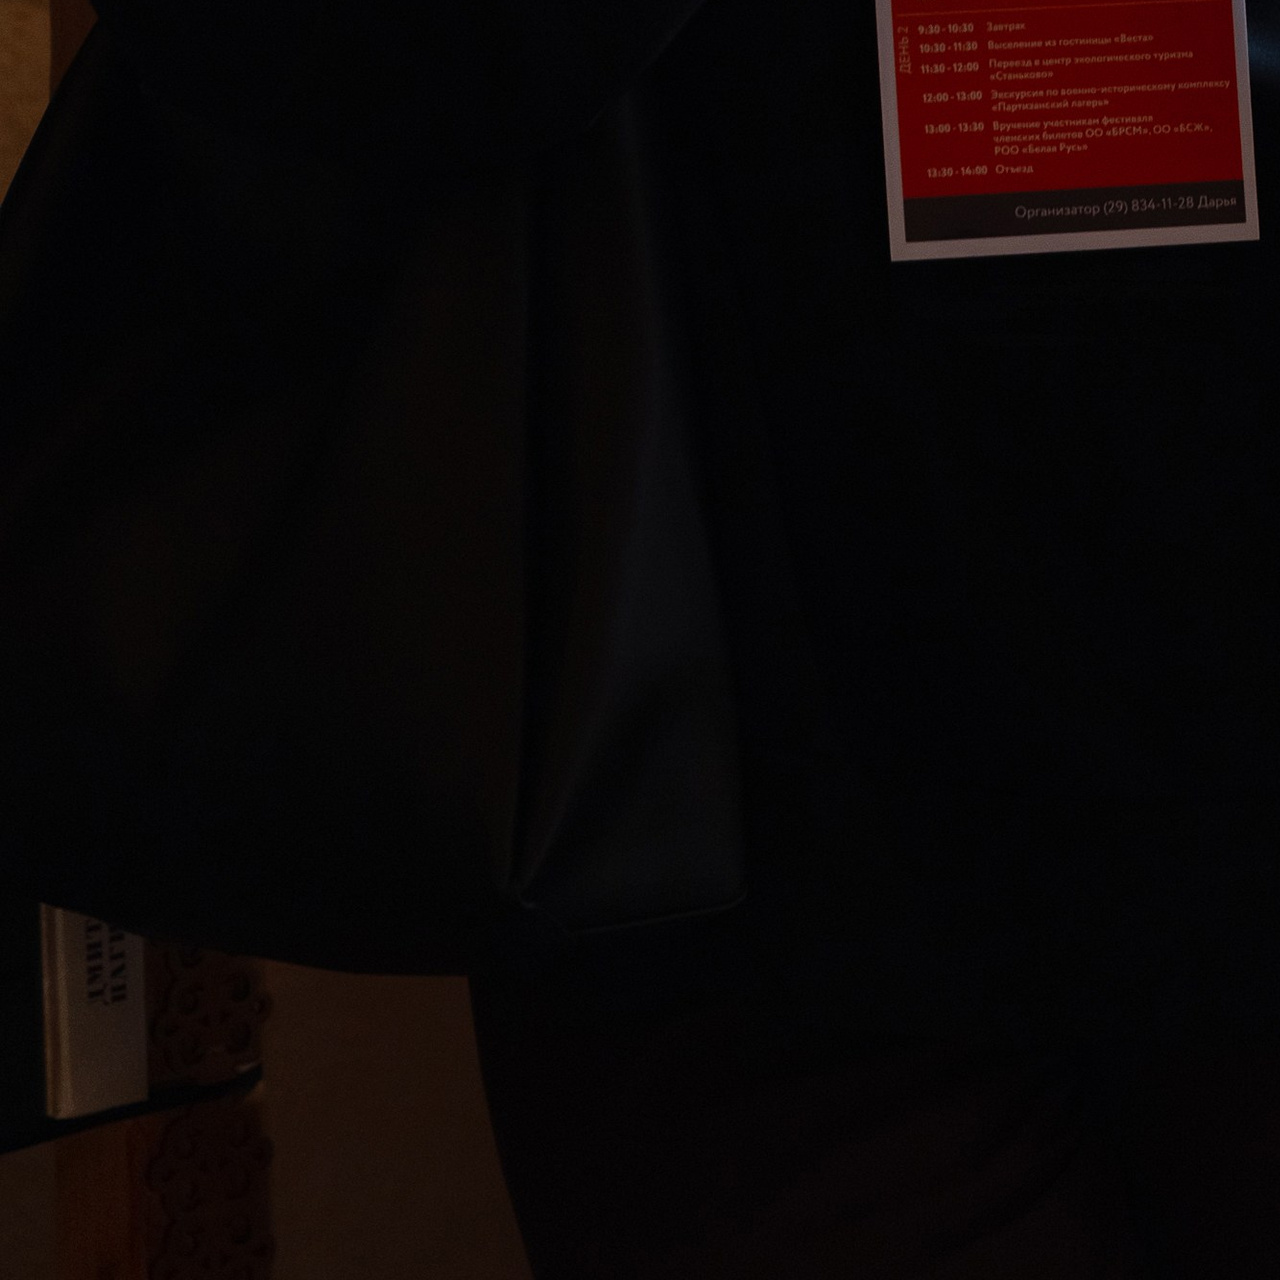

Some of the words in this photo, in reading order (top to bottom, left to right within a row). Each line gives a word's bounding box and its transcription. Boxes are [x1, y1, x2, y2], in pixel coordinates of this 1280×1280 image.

[897, 25, 908, 34] 2
[918, 24, 940, 35] 9:30
[948, 22, 974, 33] 10:30
[987, 21, 1026, 32] Завтрак
[920, 43, 946, 54] 10:30
[953, 41, 978, 52] 11:30
[988, 40, 1043, 50] Выселение
[1044, 39, 1056, 47] из
[1059, 37, 1112, 46] гостиницы
[1114, 34, 1154, 44] «Веста»
[897, 36, 912, 75] ДЕНЬ
[989, 59, 1032, 69] Переезд
[1042, 57, 1072, 66] центр
[1074, 53, 1151, 64] экологического
[1153, 51, 1193, 61] туризма
[921, 63, 946, 74] 11:30
[953, 62, 979, 73] 12:00
[923, 92, 949, 103] 12:00
[956, 90, 982, 101] 13:00
[991, 90, 1044, 100] Экскурсия
[1046, 89, 1059, 97] по
[1060, 83, 1176, 96] военно-историческому
[1178, 80, 1230, 89] комплексу
[992, 100, 1069, 112] «Партизанский
[1071, 99, 1109, 108] лагерь»
[924, 123, 951, 134] 13:00
[958, 121, 984, 132] 13:30
[993, 121, 1040, 132] Вручение
[1043, 118, 1099, 129] участникам
[1101, 115, 1153, 126] фестиваля
[993, 134, 1040, 143] членских
[1042, 131, 1083, 141] билетов
[1085, 128, 1103, 138] ОО
[1106, 126, 1151, 137] «БРСМ»,
[1153, 124, 1171, 135] ОО
[1174, 122, 1212, 133] «БСЖ»,
[994, 145, 1019, 156] РОО
[1022, 144, 1057, 154] «Белая
[1059, 142, 1088, 154] Русь»
[927, 167, 953, 178] 13:30
[961, 165, 988, 176] 14:00
[995, 164, 1034, 174] Отъезд
[1015, 205, 1100, 219] Организатор
[1104, 200, 1128, 215] (29)
[1132, 196, 1194, 212] 834-11-28
[1198, 195, 1236, 209] Дарья
